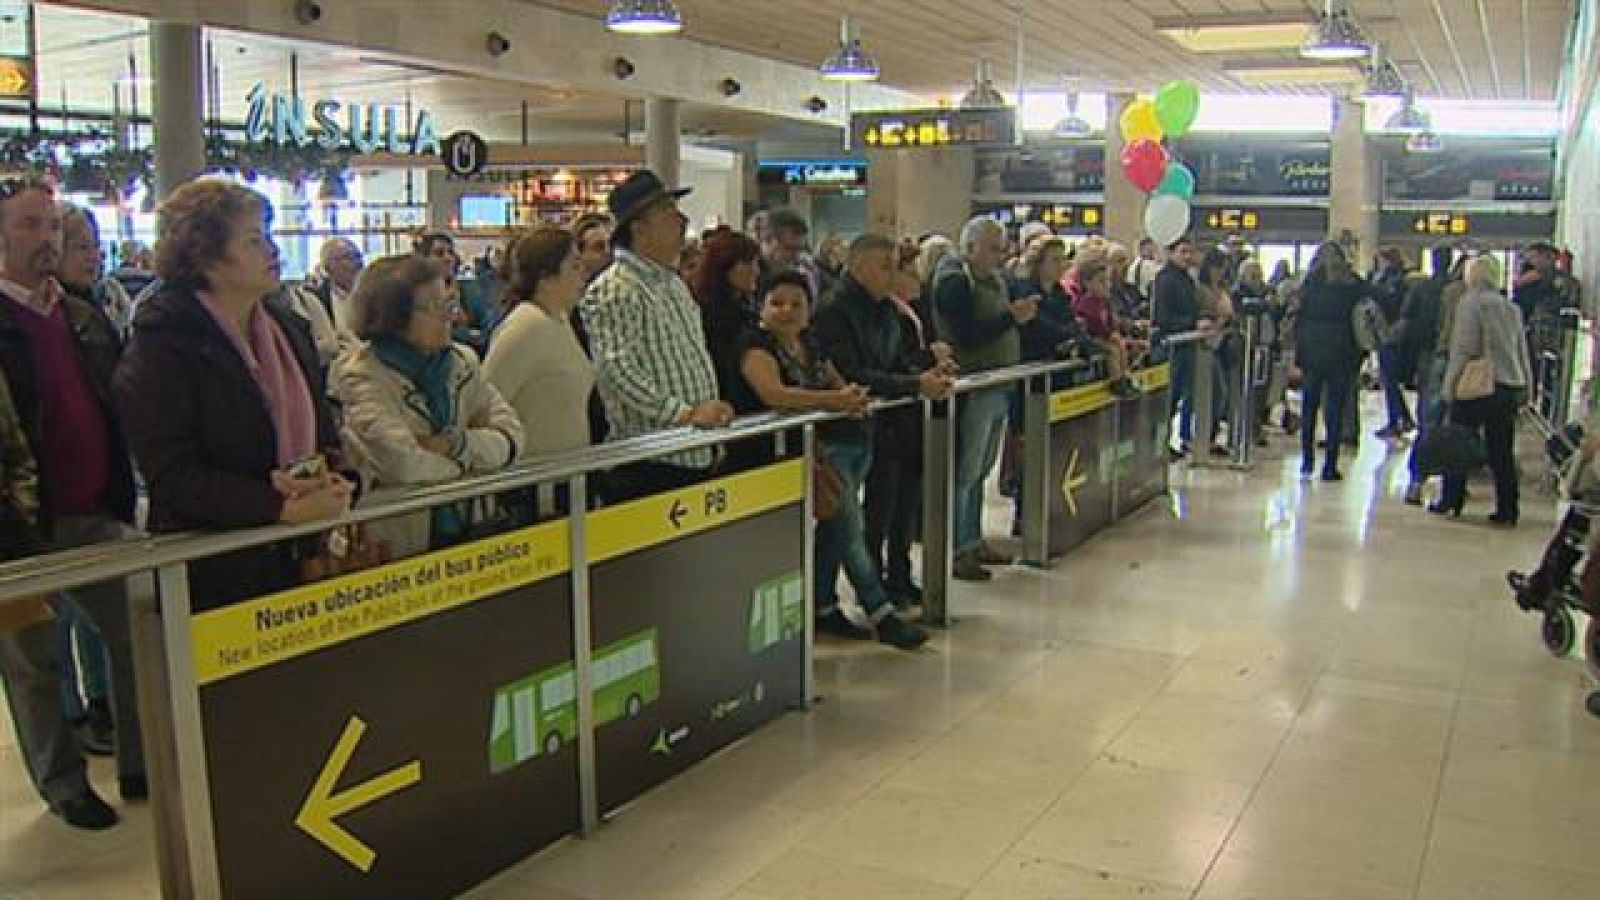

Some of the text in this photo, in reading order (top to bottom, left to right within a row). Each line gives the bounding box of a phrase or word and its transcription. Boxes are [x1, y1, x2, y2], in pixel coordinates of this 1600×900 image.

[704, 488, 727, 517] PB
[256, 601, 317, 631] Nueva
[325, 572, 410, 612] ubicación
[416, 561, 441, 586] del
[445, 555, 472, 579] bus
[477, 541, 530, 572] público
[218, 646, 250, 667] New
[257, 625, 315, 656] location
[320, 619, 333, 638] of
[336, 611, 359, 632] the
[362, 598, 400, 625] Public
